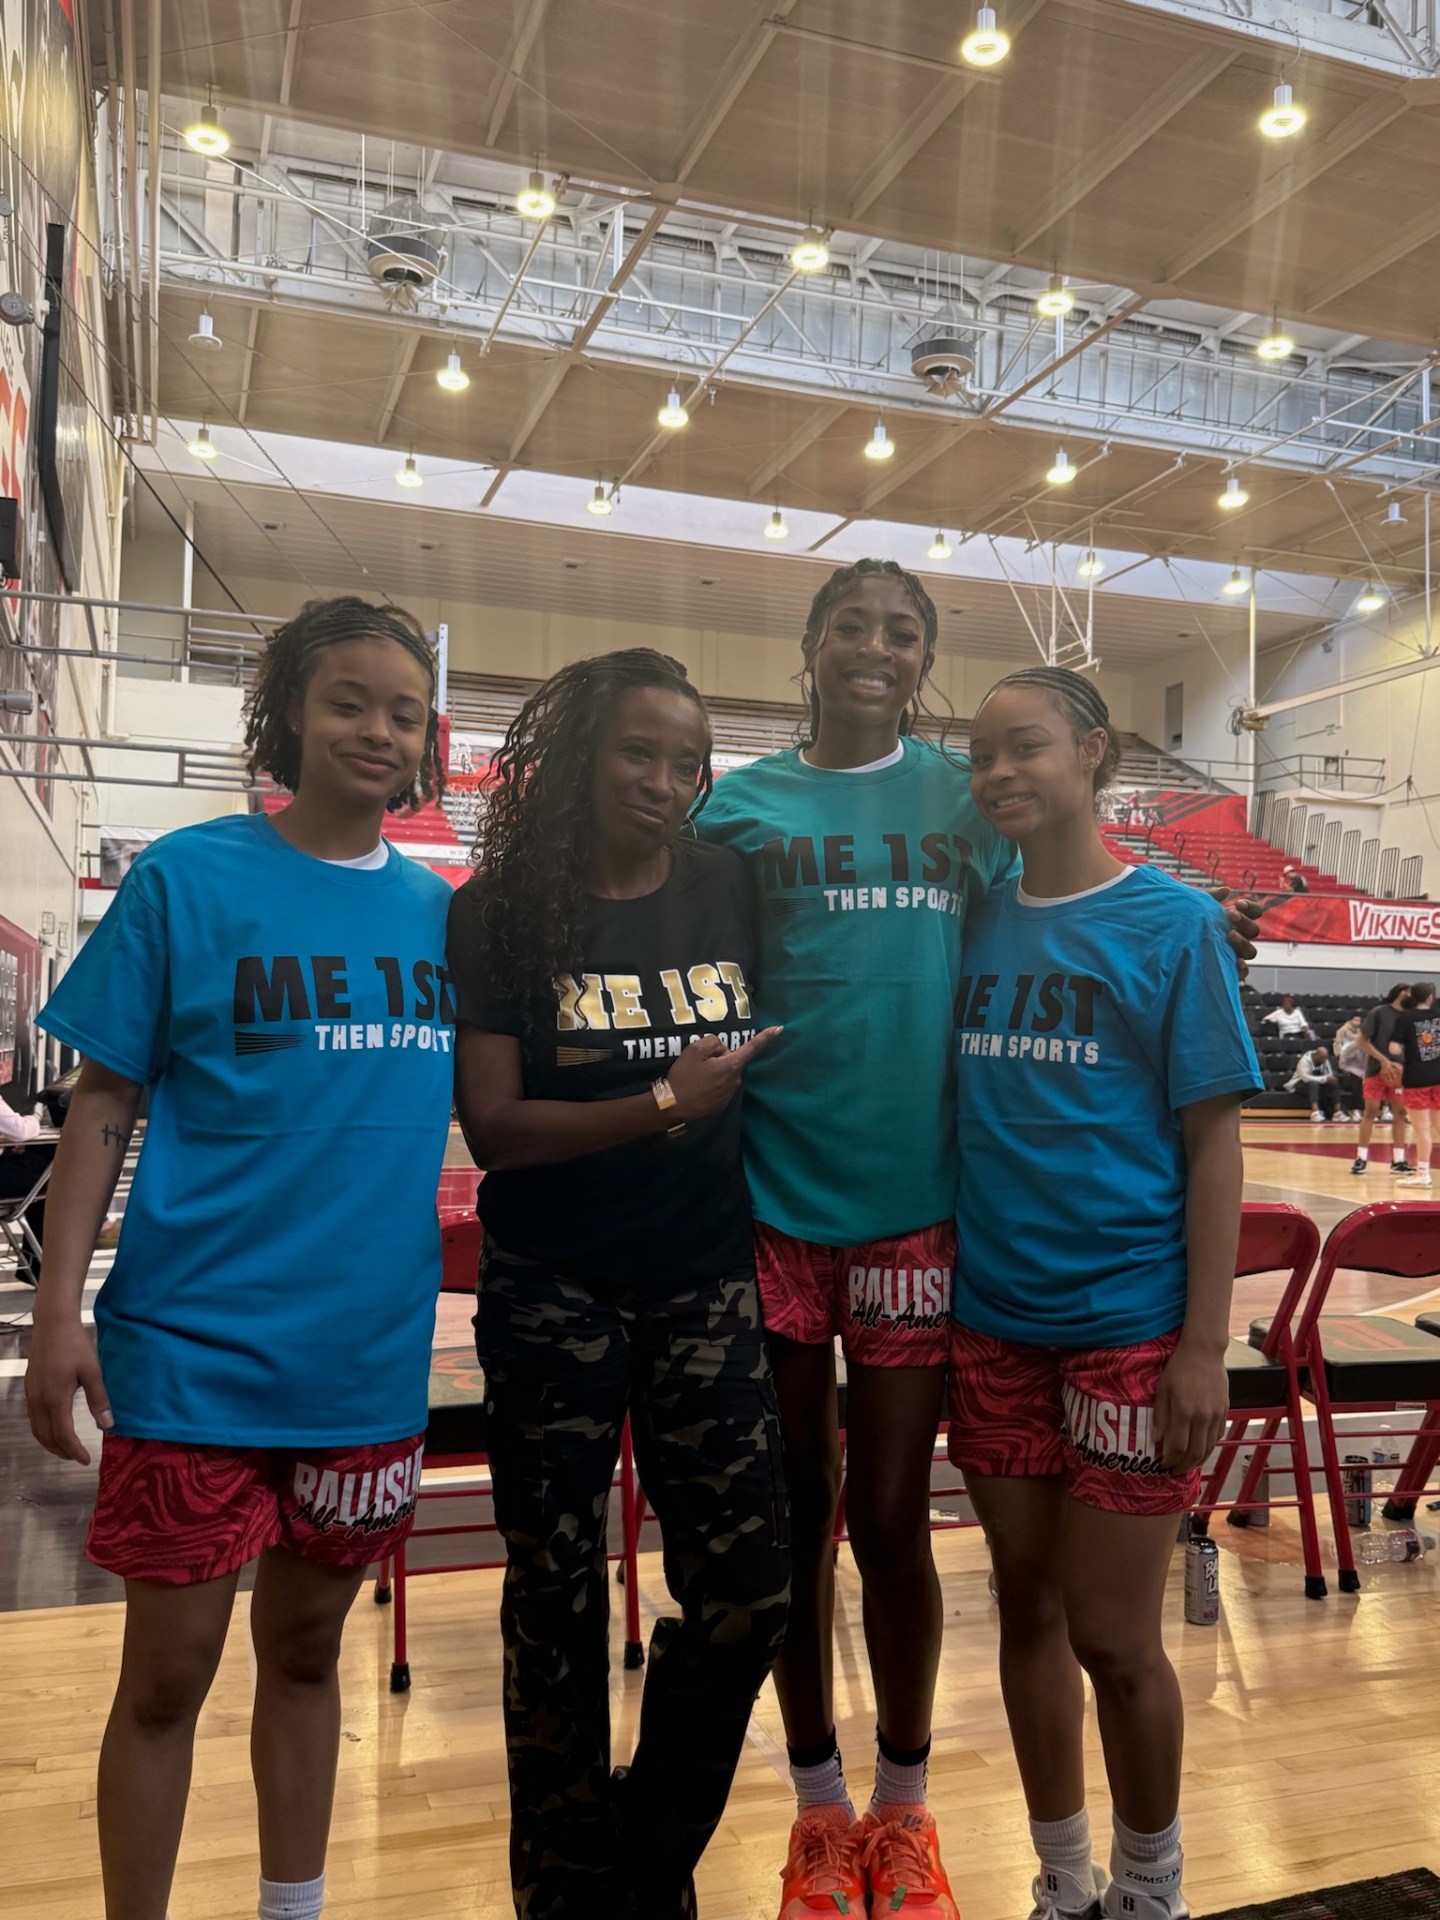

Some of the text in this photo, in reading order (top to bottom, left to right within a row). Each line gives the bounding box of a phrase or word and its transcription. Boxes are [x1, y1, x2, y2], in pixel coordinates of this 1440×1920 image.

[762, 832, 973, 892] ME 1ST
[823, 886, 964, 917] THEN SPORTS
[234, 956, 457, 1025] ME 1ST
[552, 961, 752, 1031] ME 1ST
[1007, 973, 1103, 1036] 1ST
[315, 1023, 456, 1053] THEN SPORT
[623, 1035, 681, 1060] THEN
[961, 1033, 1100, 1065] THEN SPORTS
